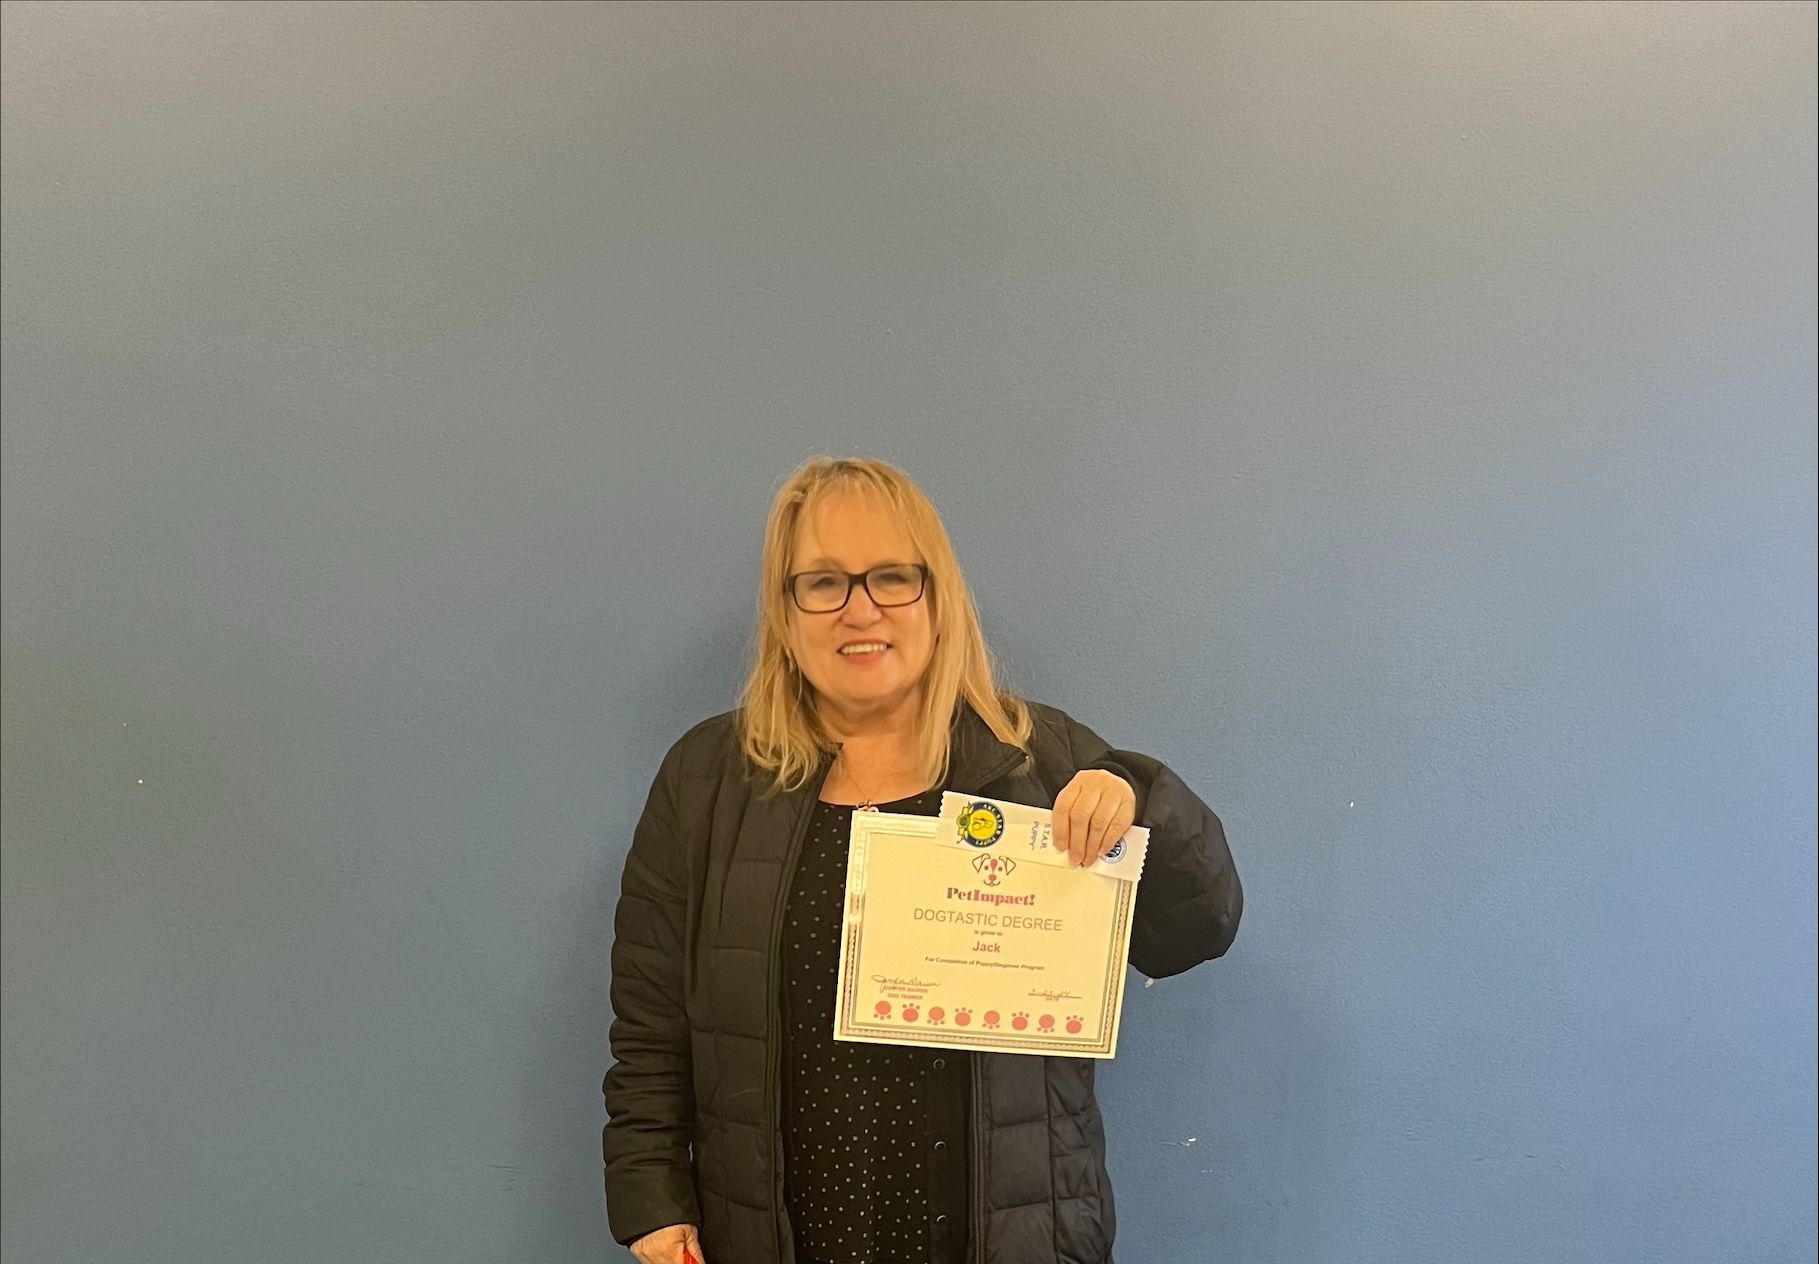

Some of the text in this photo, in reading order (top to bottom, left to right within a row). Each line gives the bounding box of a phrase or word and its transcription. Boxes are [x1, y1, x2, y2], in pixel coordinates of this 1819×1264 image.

[946, 887, 1036, 906] PetImpact!
[913, 908, 1064, 932] DOGTASTIC DEGREE
[972, 941, 1001, 953] Jack
